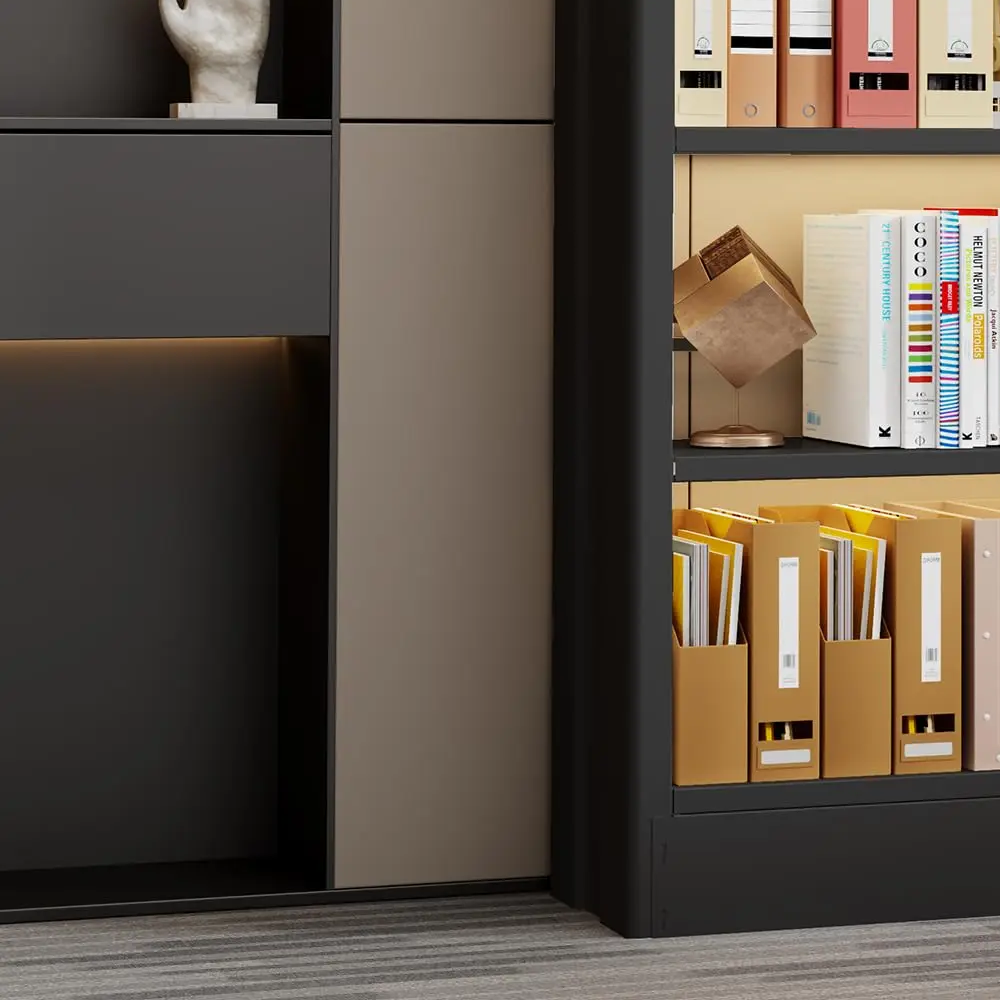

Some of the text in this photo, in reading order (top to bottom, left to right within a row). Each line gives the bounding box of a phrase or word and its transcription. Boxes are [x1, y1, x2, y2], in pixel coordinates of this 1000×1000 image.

[882, 240, 890, 286] CENTURY
[914, 222, 927, 278] COCO
[882, 288, 890, 321] HOUSE
[973, 236, 984, 358] HELMUT NEWTON Polaroids
